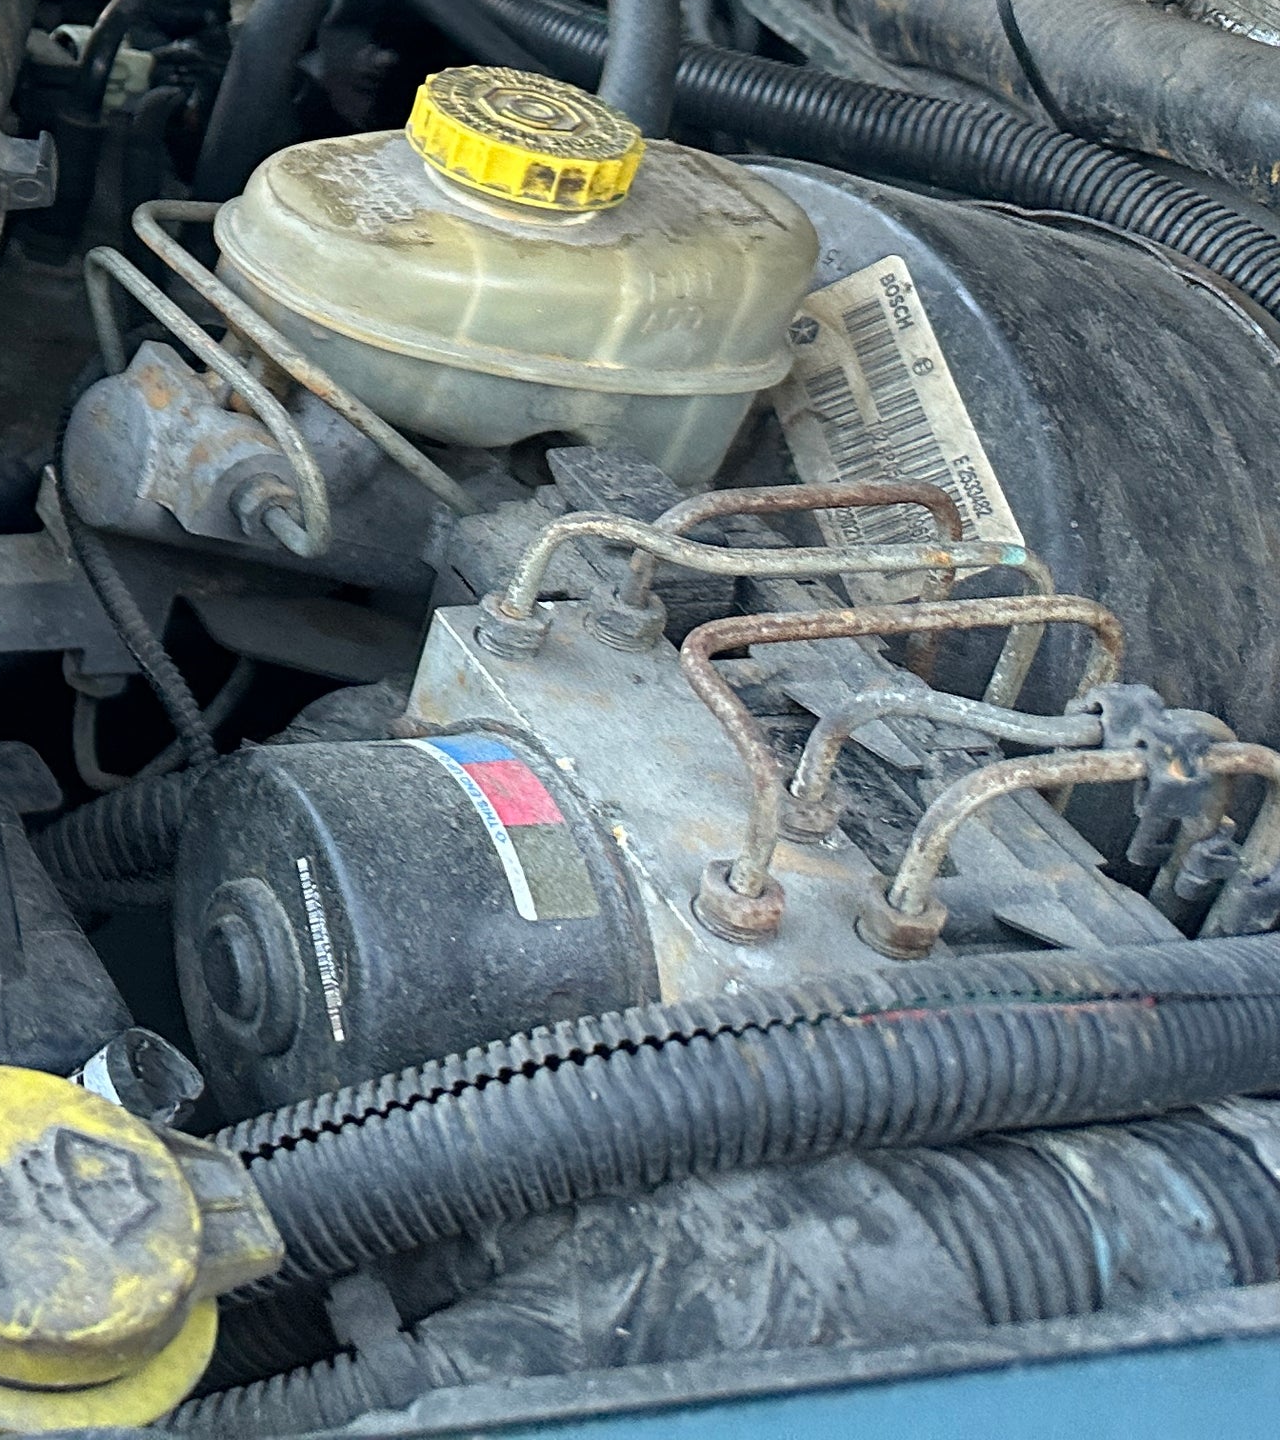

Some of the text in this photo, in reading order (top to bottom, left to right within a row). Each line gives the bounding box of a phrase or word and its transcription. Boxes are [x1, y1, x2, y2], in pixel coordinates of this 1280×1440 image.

[880, 273, 914, 331] BOSCH
[446, 762, 500, 828] THIS END UP
